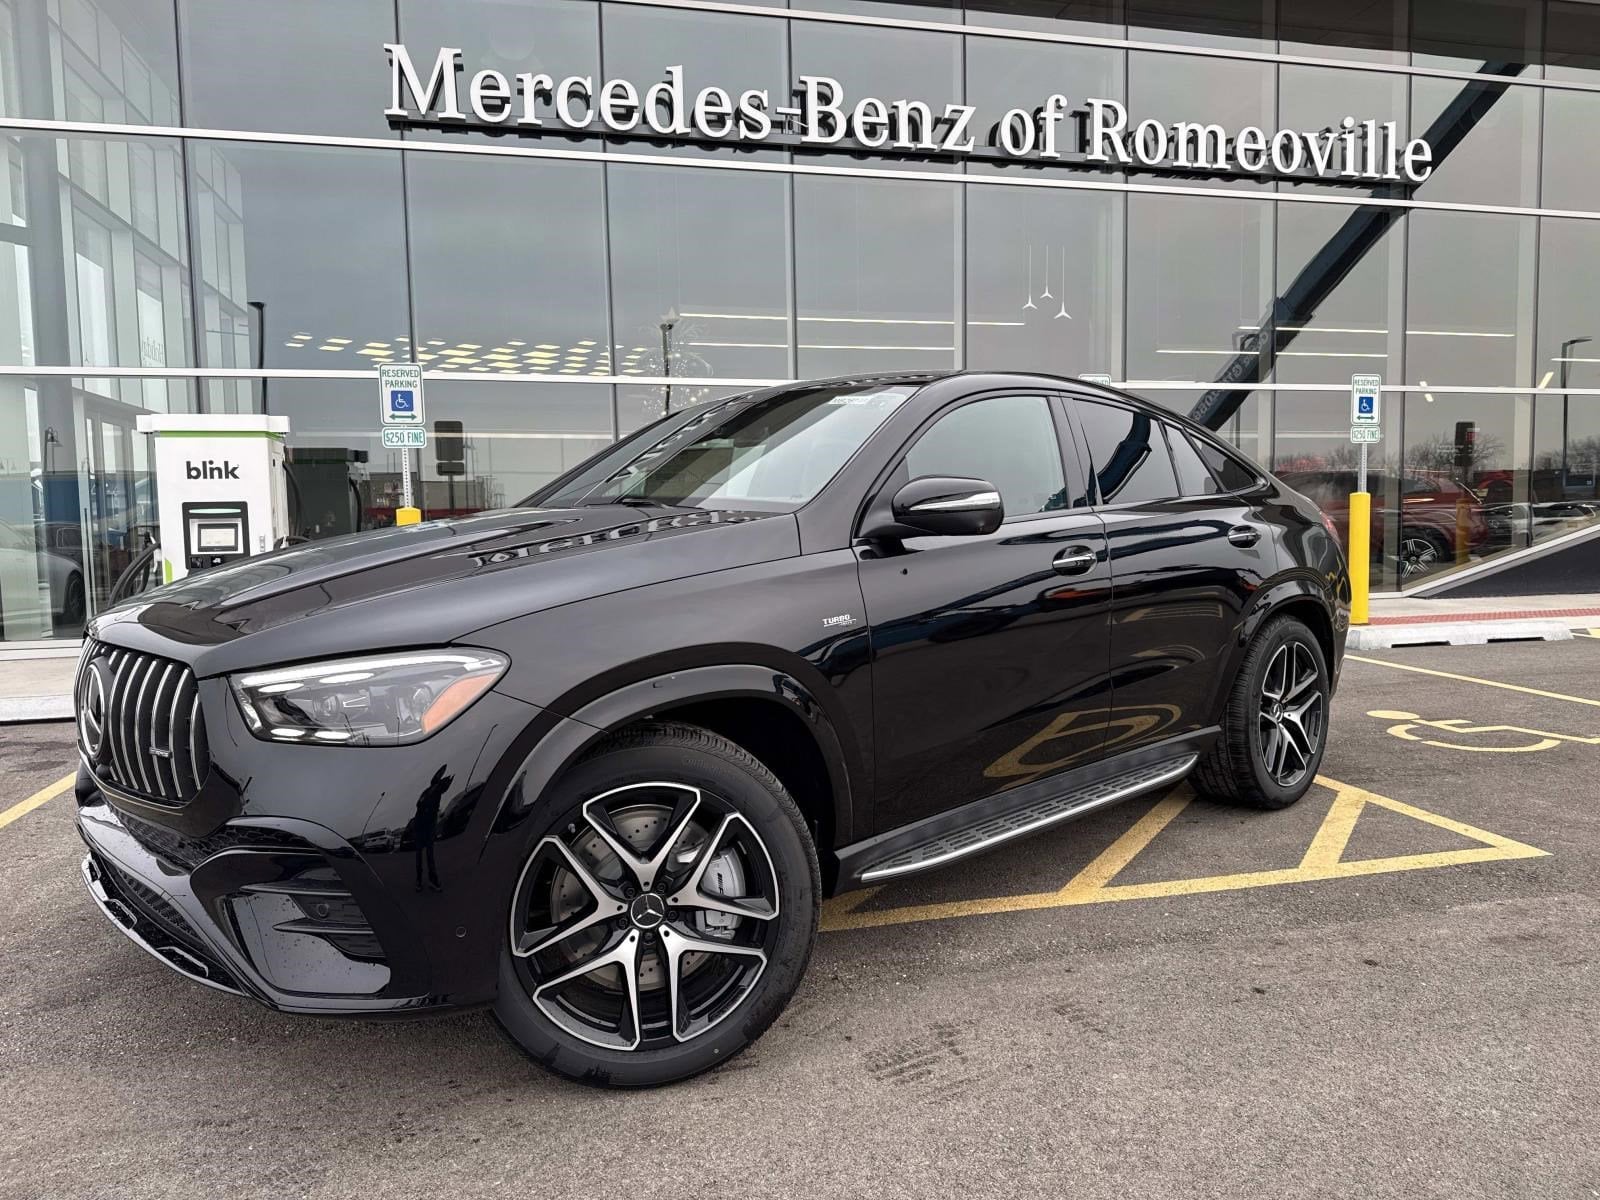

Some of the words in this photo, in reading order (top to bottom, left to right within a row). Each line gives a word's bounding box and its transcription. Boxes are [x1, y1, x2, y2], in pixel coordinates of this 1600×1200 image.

[384, 43, 977, 153] Mercedes-Benz
[1000, 94, 1068, 159] of
[1087, 98, 1433, 183] Romeoville
[382, 369, 419, 378] RESERVED
[385, 380, 418, 389] PARKING
[1354, 379, 1379, 387] RESERVED
[385, 431, 405, 444] $250
[407, 431, 424, 444] FINE
[1366, 429, 1378, 440] FINE
[186, 460, 240, 480] blink
[822, 614, 850, 625] TURBO
